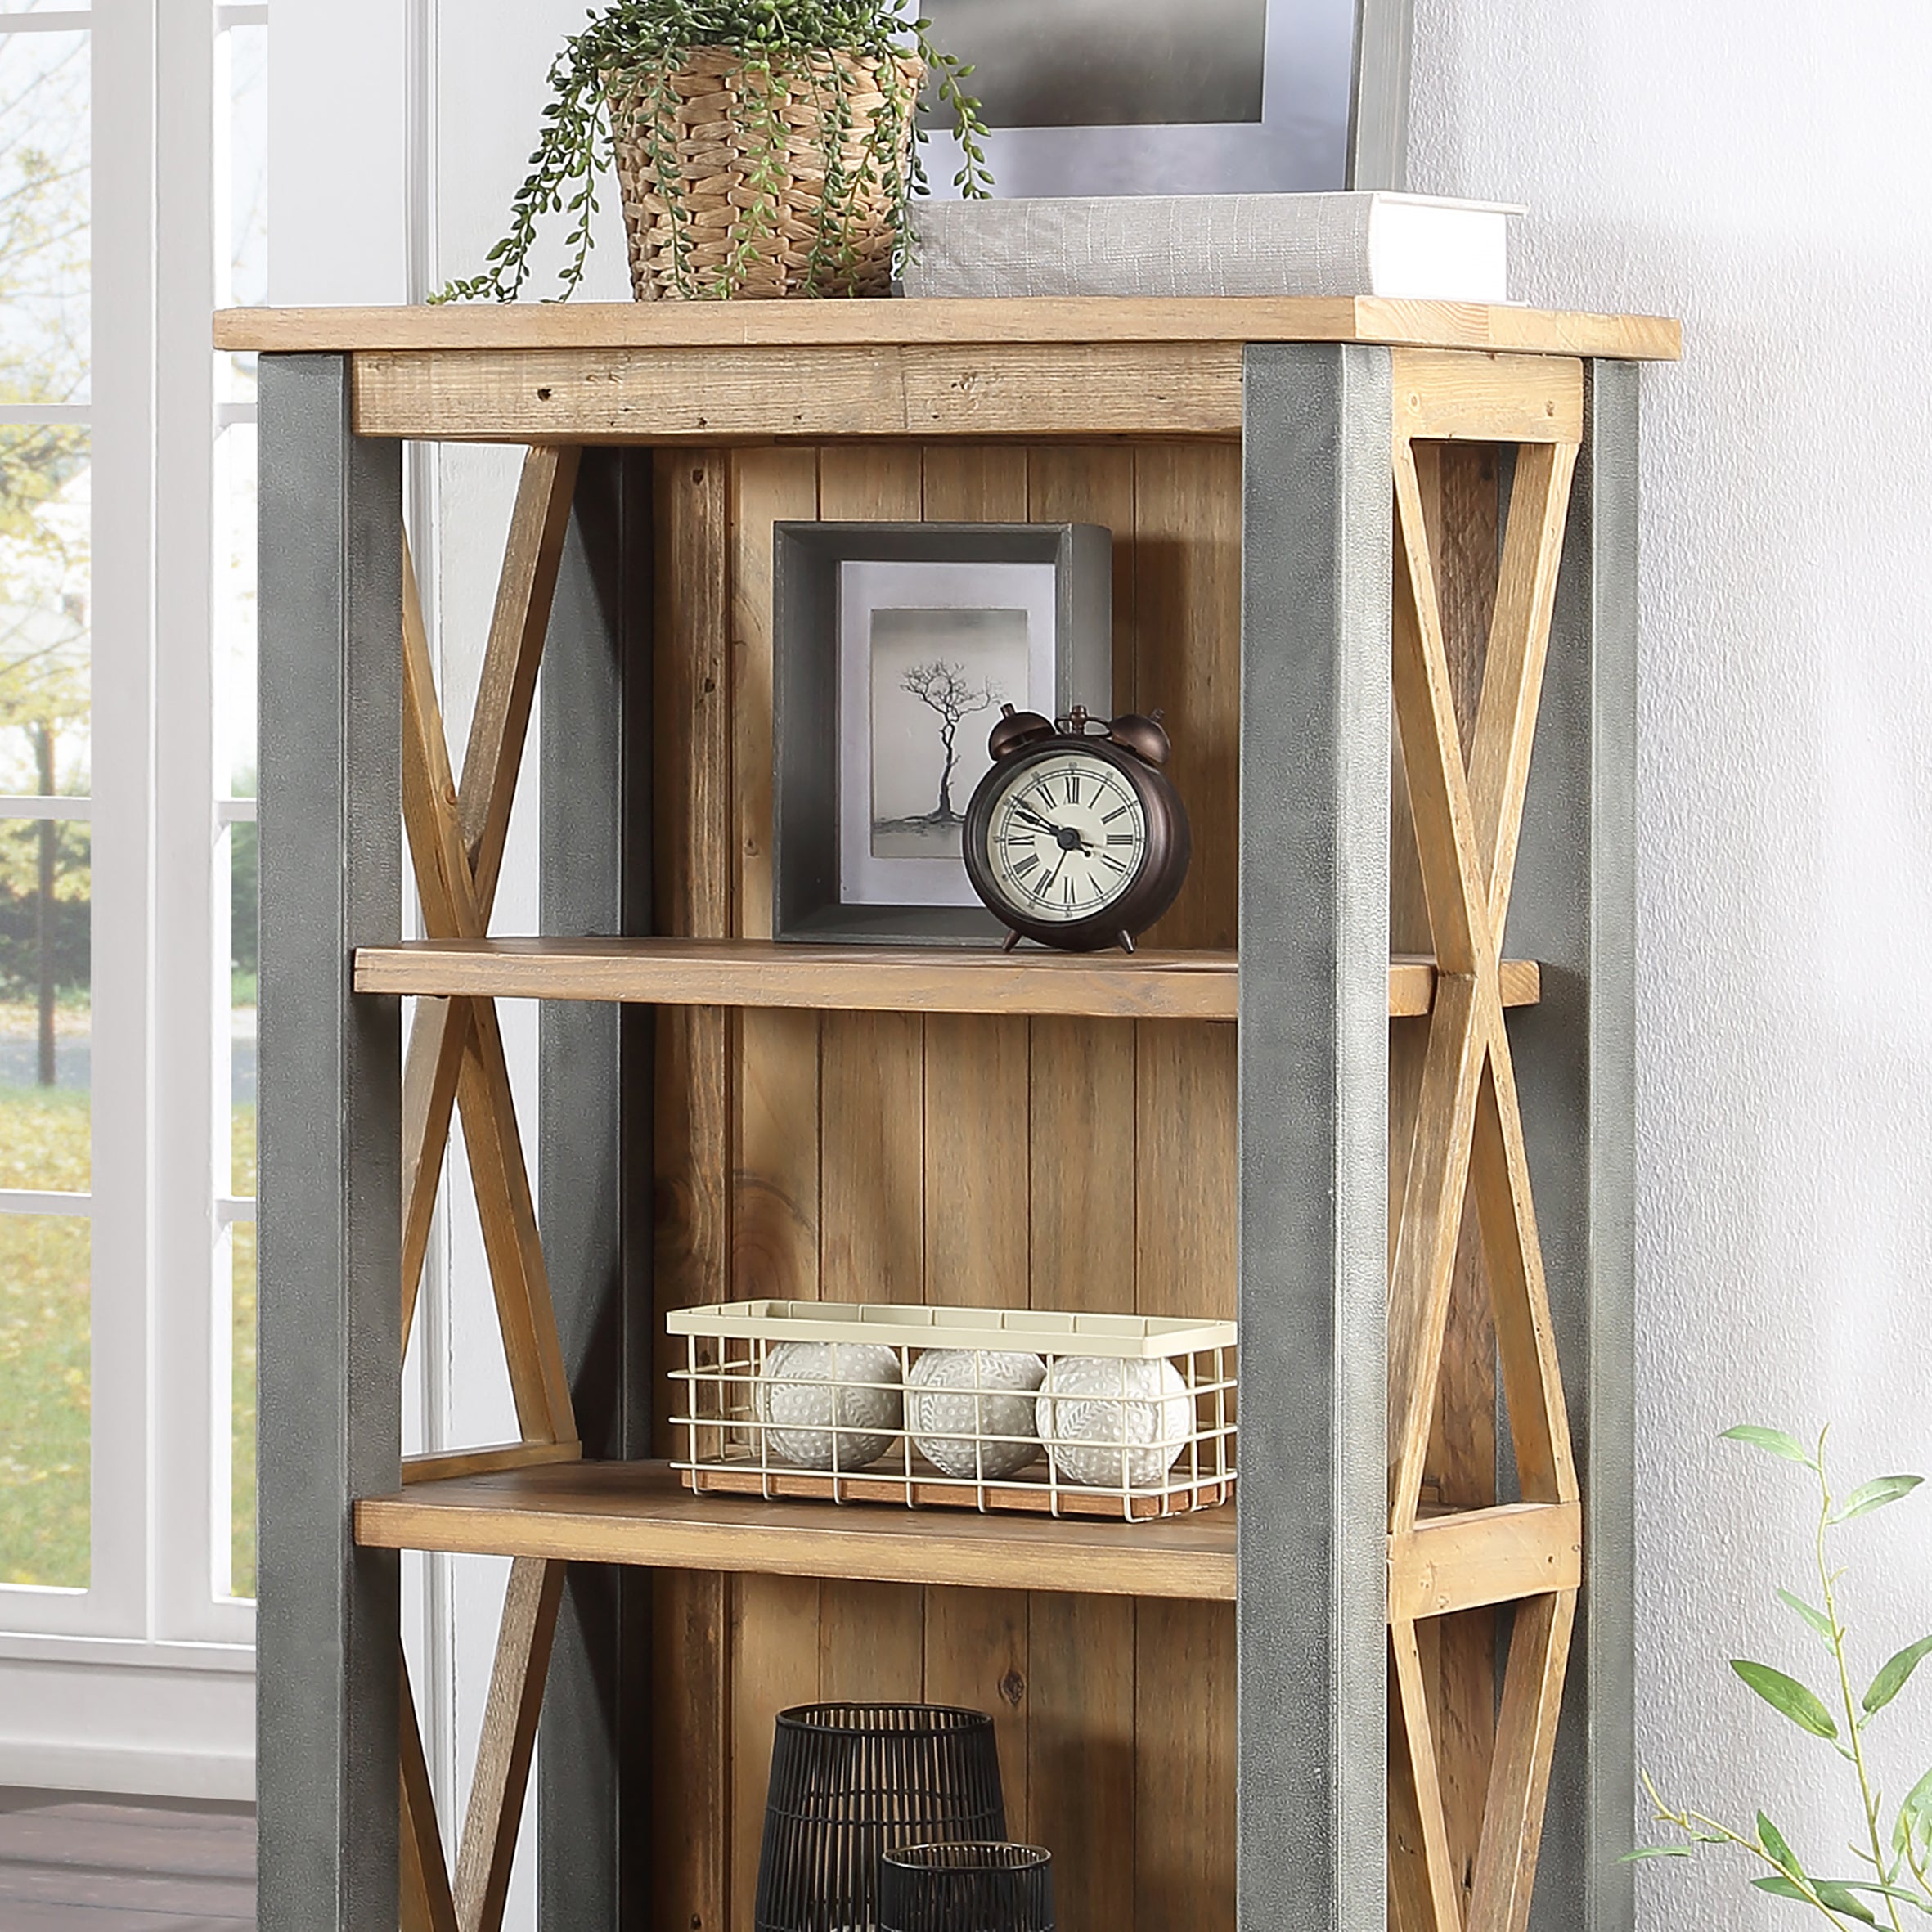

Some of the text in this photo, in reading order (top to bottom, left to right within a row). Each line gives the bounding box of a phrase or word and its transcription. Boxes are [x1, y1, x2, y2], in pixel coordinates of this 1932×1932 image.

[1036, 783, 1058, 812] XI
[1063, 776, 1080, 805] XII
[1088, 784, 1105, 809] I
[1101, 806, 1127, 824] II
[1008, 834, 1035, 846] IX
[1107, 834, 1133, 845] III
[1064, 876, 1076, 904] VI
[1087, 871, 1103, 897] V
